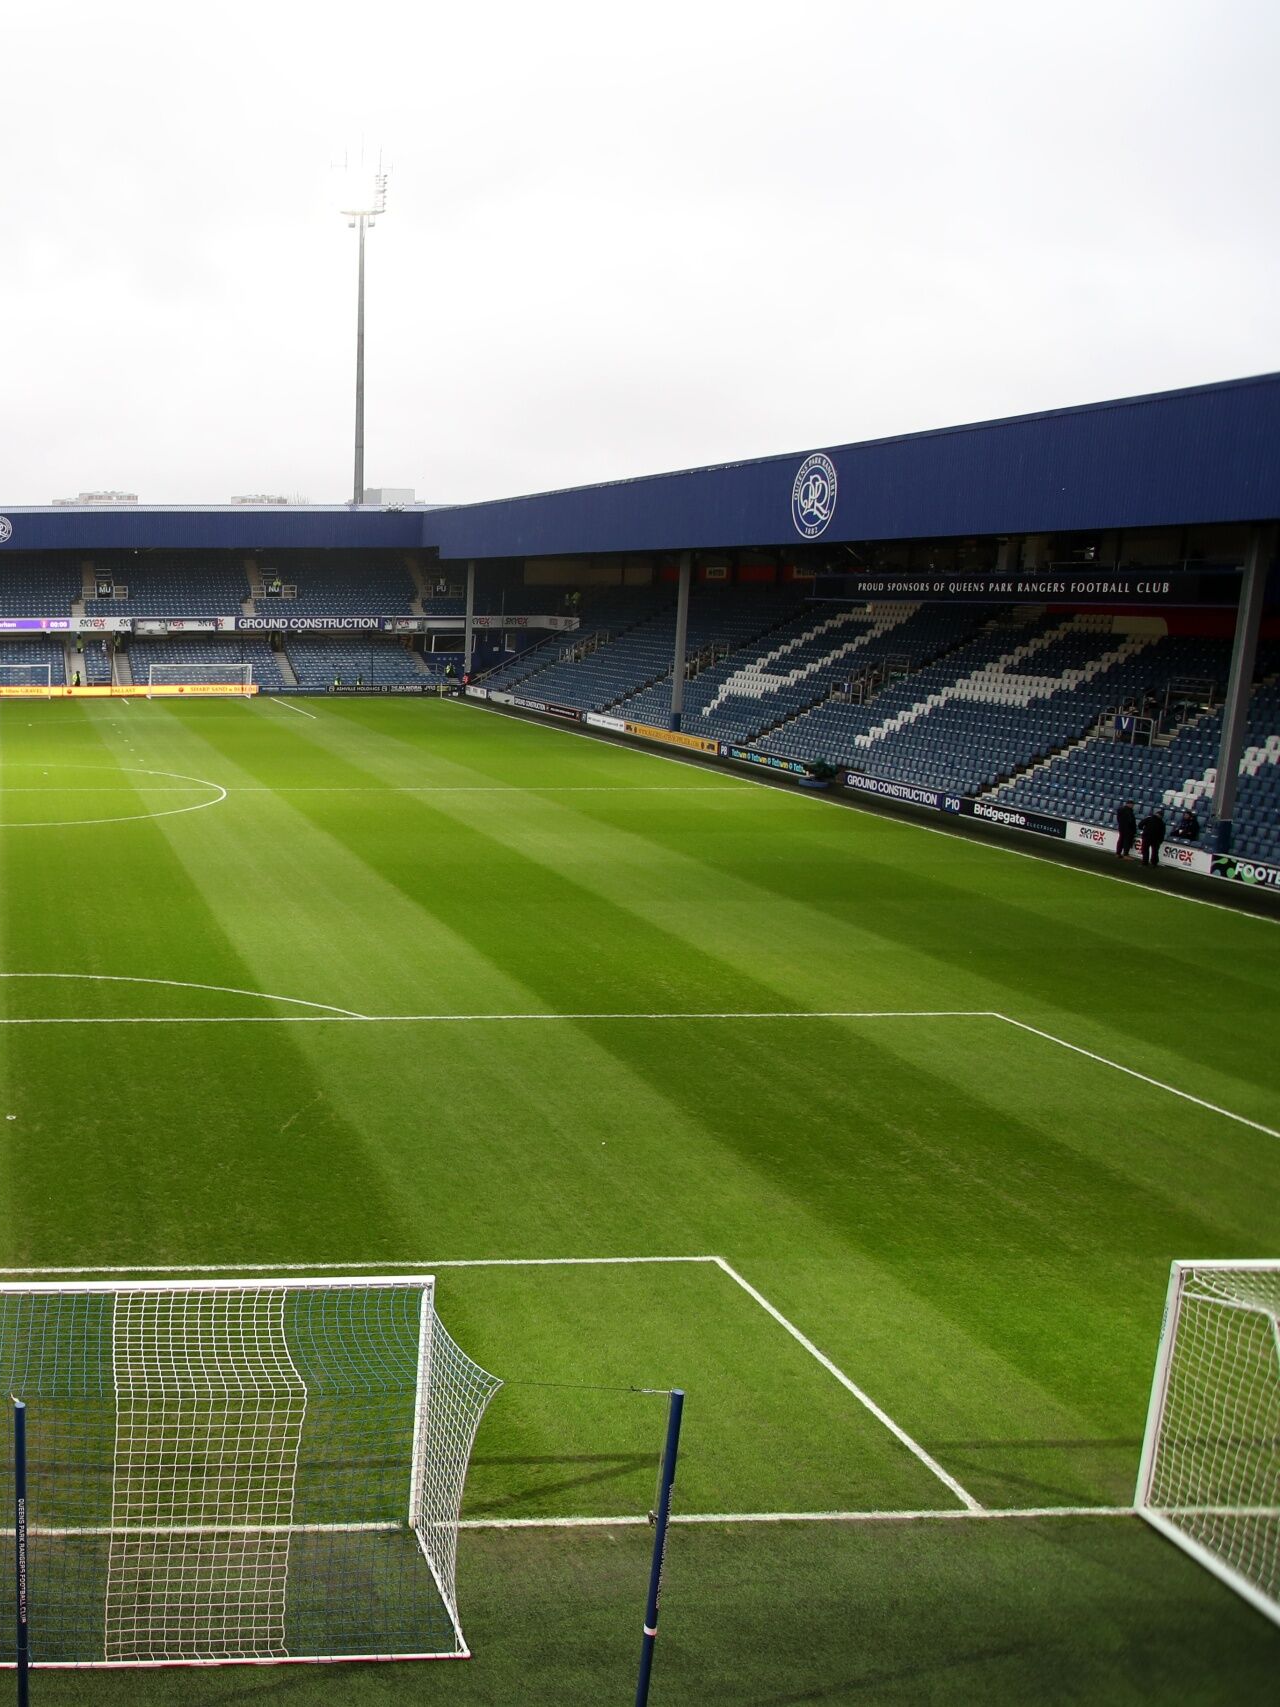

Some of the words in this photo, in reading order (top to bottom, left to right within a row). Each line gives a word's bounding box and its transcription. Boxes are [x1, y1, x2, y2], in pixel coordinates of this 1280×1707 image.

[857, 582, 884, 592] PROUD
[887, 582, 930, 592] SPONSORS
[933, 582, 945, 592] OF
[948, 582, 984, 594] QUEENS
[988, 582, 1013, 592] PARK
[1017, 582, 1066, 592] RANGERS
[1070, 582, 1130, 593] FOOTBALL
[1136, 582, 1170, 593] CLUB
[238, 618, 289, 629] GROUND
[290, 618, 379, 629] CONSTRUCTION
[847, 774, 878, 791] GROUND
[878, 781, 938, 806] CONSTRUCTION
[945, 797, 960, 811] P10
[973, 803, 1026, 826] Bridgegate
[1026, 821, 1061, 834] ELECTRICAL
